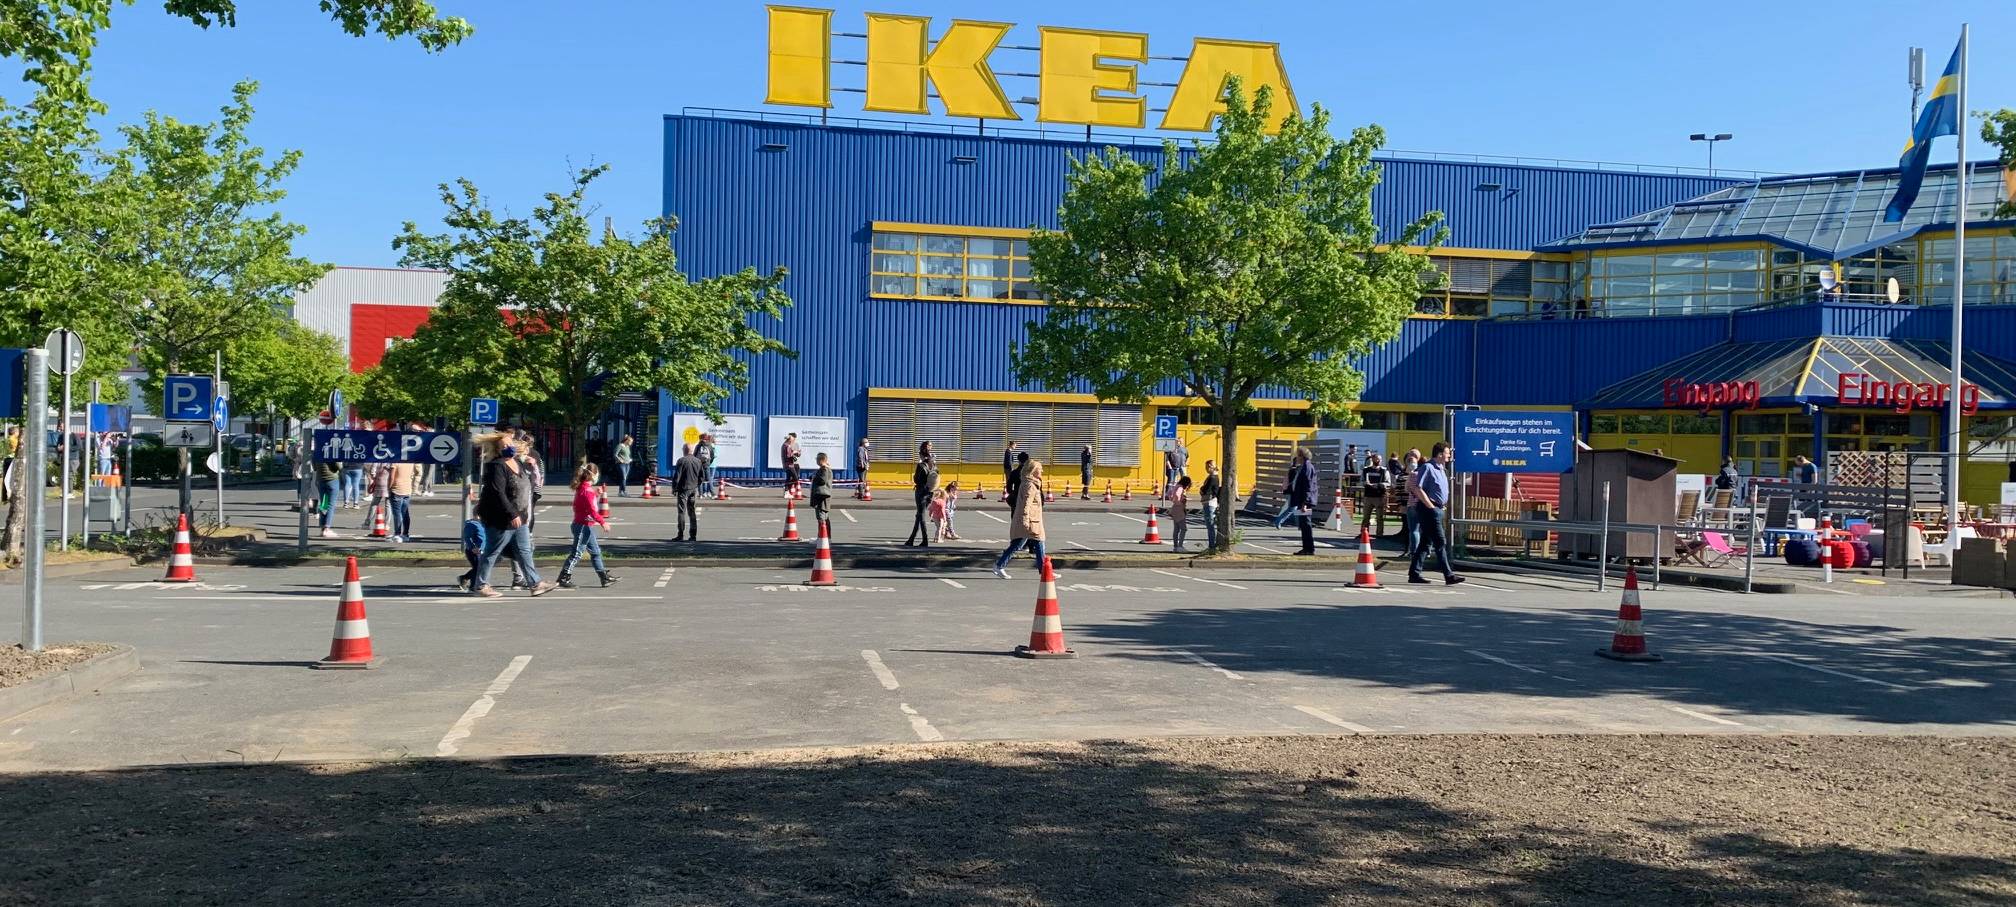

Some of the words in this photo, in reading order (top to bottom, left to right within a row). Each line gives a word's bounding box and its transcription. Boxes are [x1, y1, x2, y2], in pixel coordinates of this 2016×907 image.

[764, 4, 1305, 136] IKEA
[172, 382, 198, 415] P
[1663, 378, 1760, 414] Eingang
[475, 402, 490, 420] P
[1475, 418, 1521, 426] Einkaufswagen
[1158, 418, 1171, 436] P
[1464, 426, 1517, 435] Einrichtungshaus
[1542, 427, 1563, 435] bereit.
[401, 434, 424, 461] P
